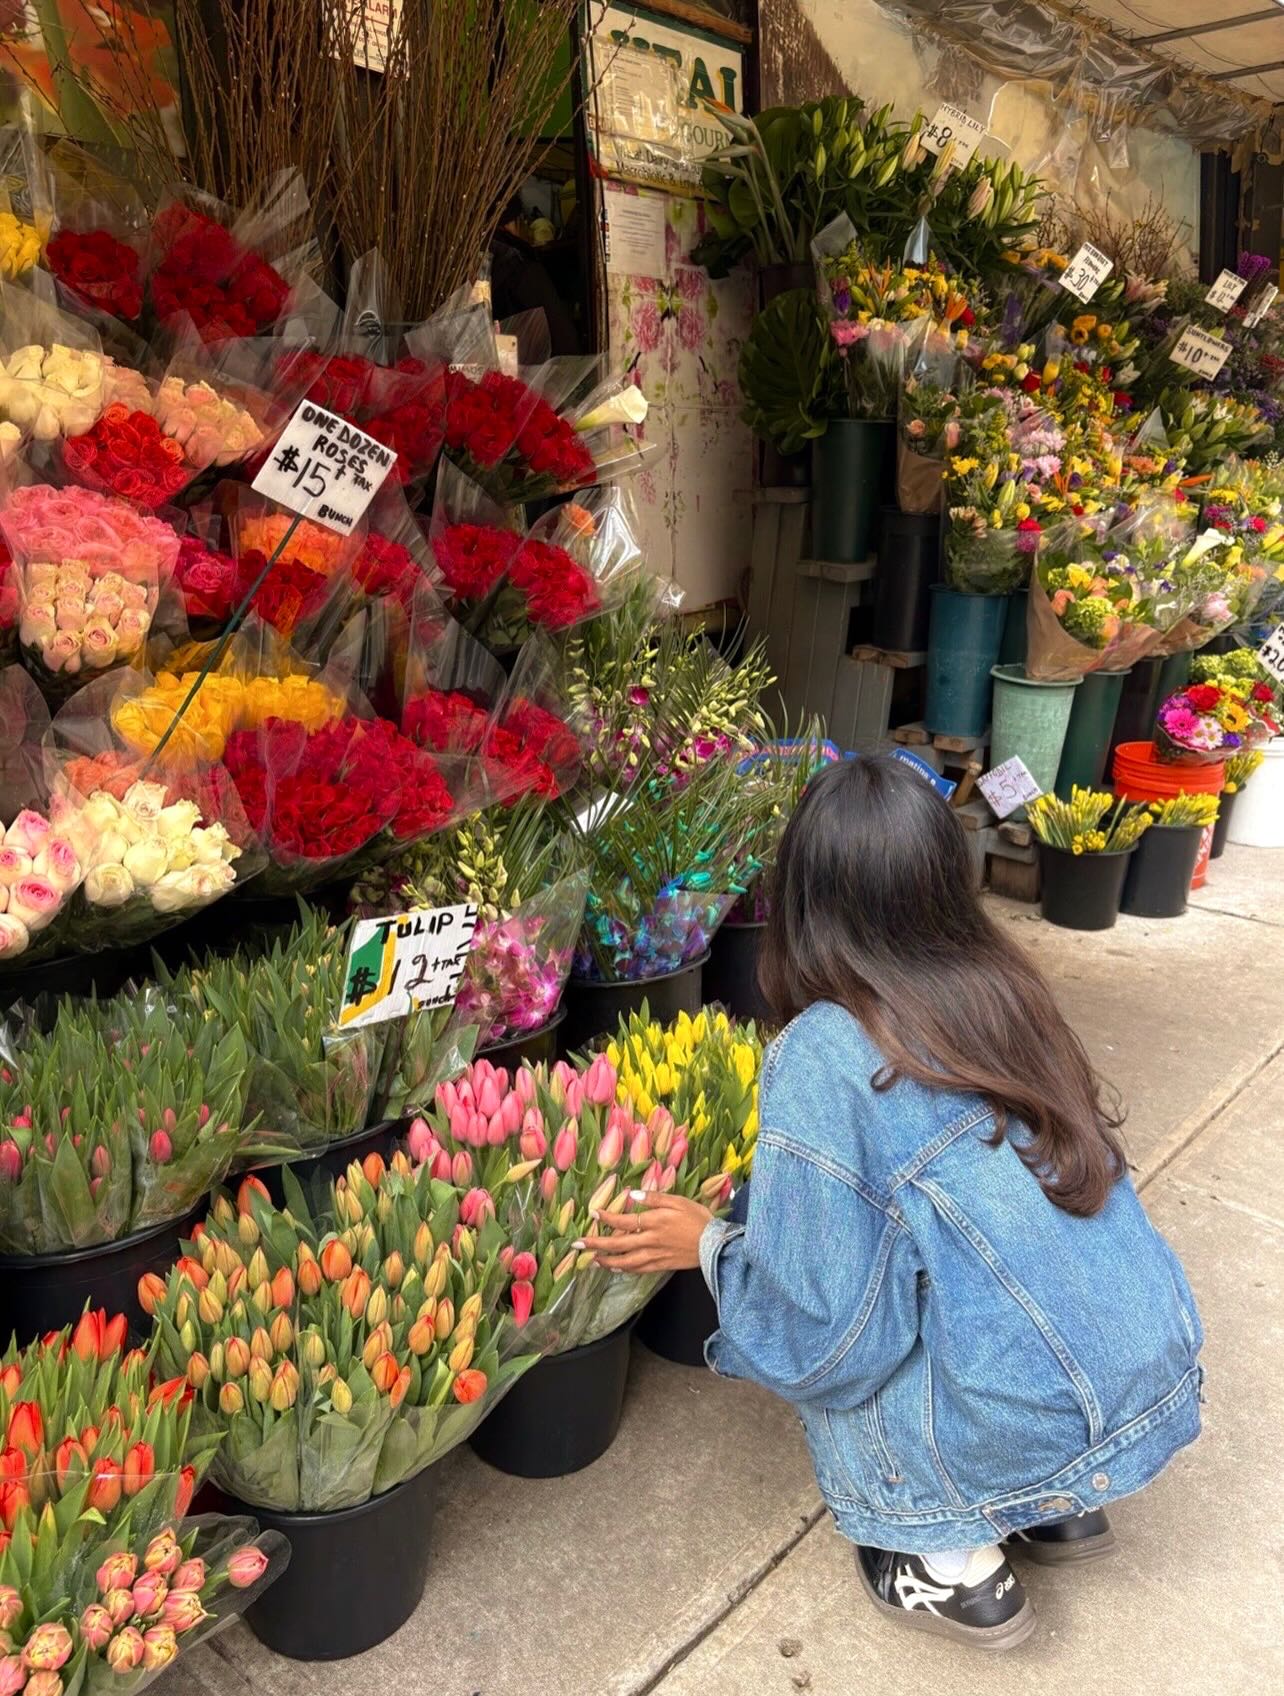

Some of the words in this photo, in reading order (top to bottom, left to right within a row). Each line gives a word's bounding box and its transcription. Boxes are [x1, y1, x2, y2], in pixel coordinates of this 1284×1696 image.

[301, 405, 339, 434] ONE
[337, 425, 391, 467] DOZEN
[311, 434, 369, 475] ROSES
[273, 444, 332, 498] $15
[353, 473, 373, 492] TAX
[317, 504, 353, 528] BUNCH
